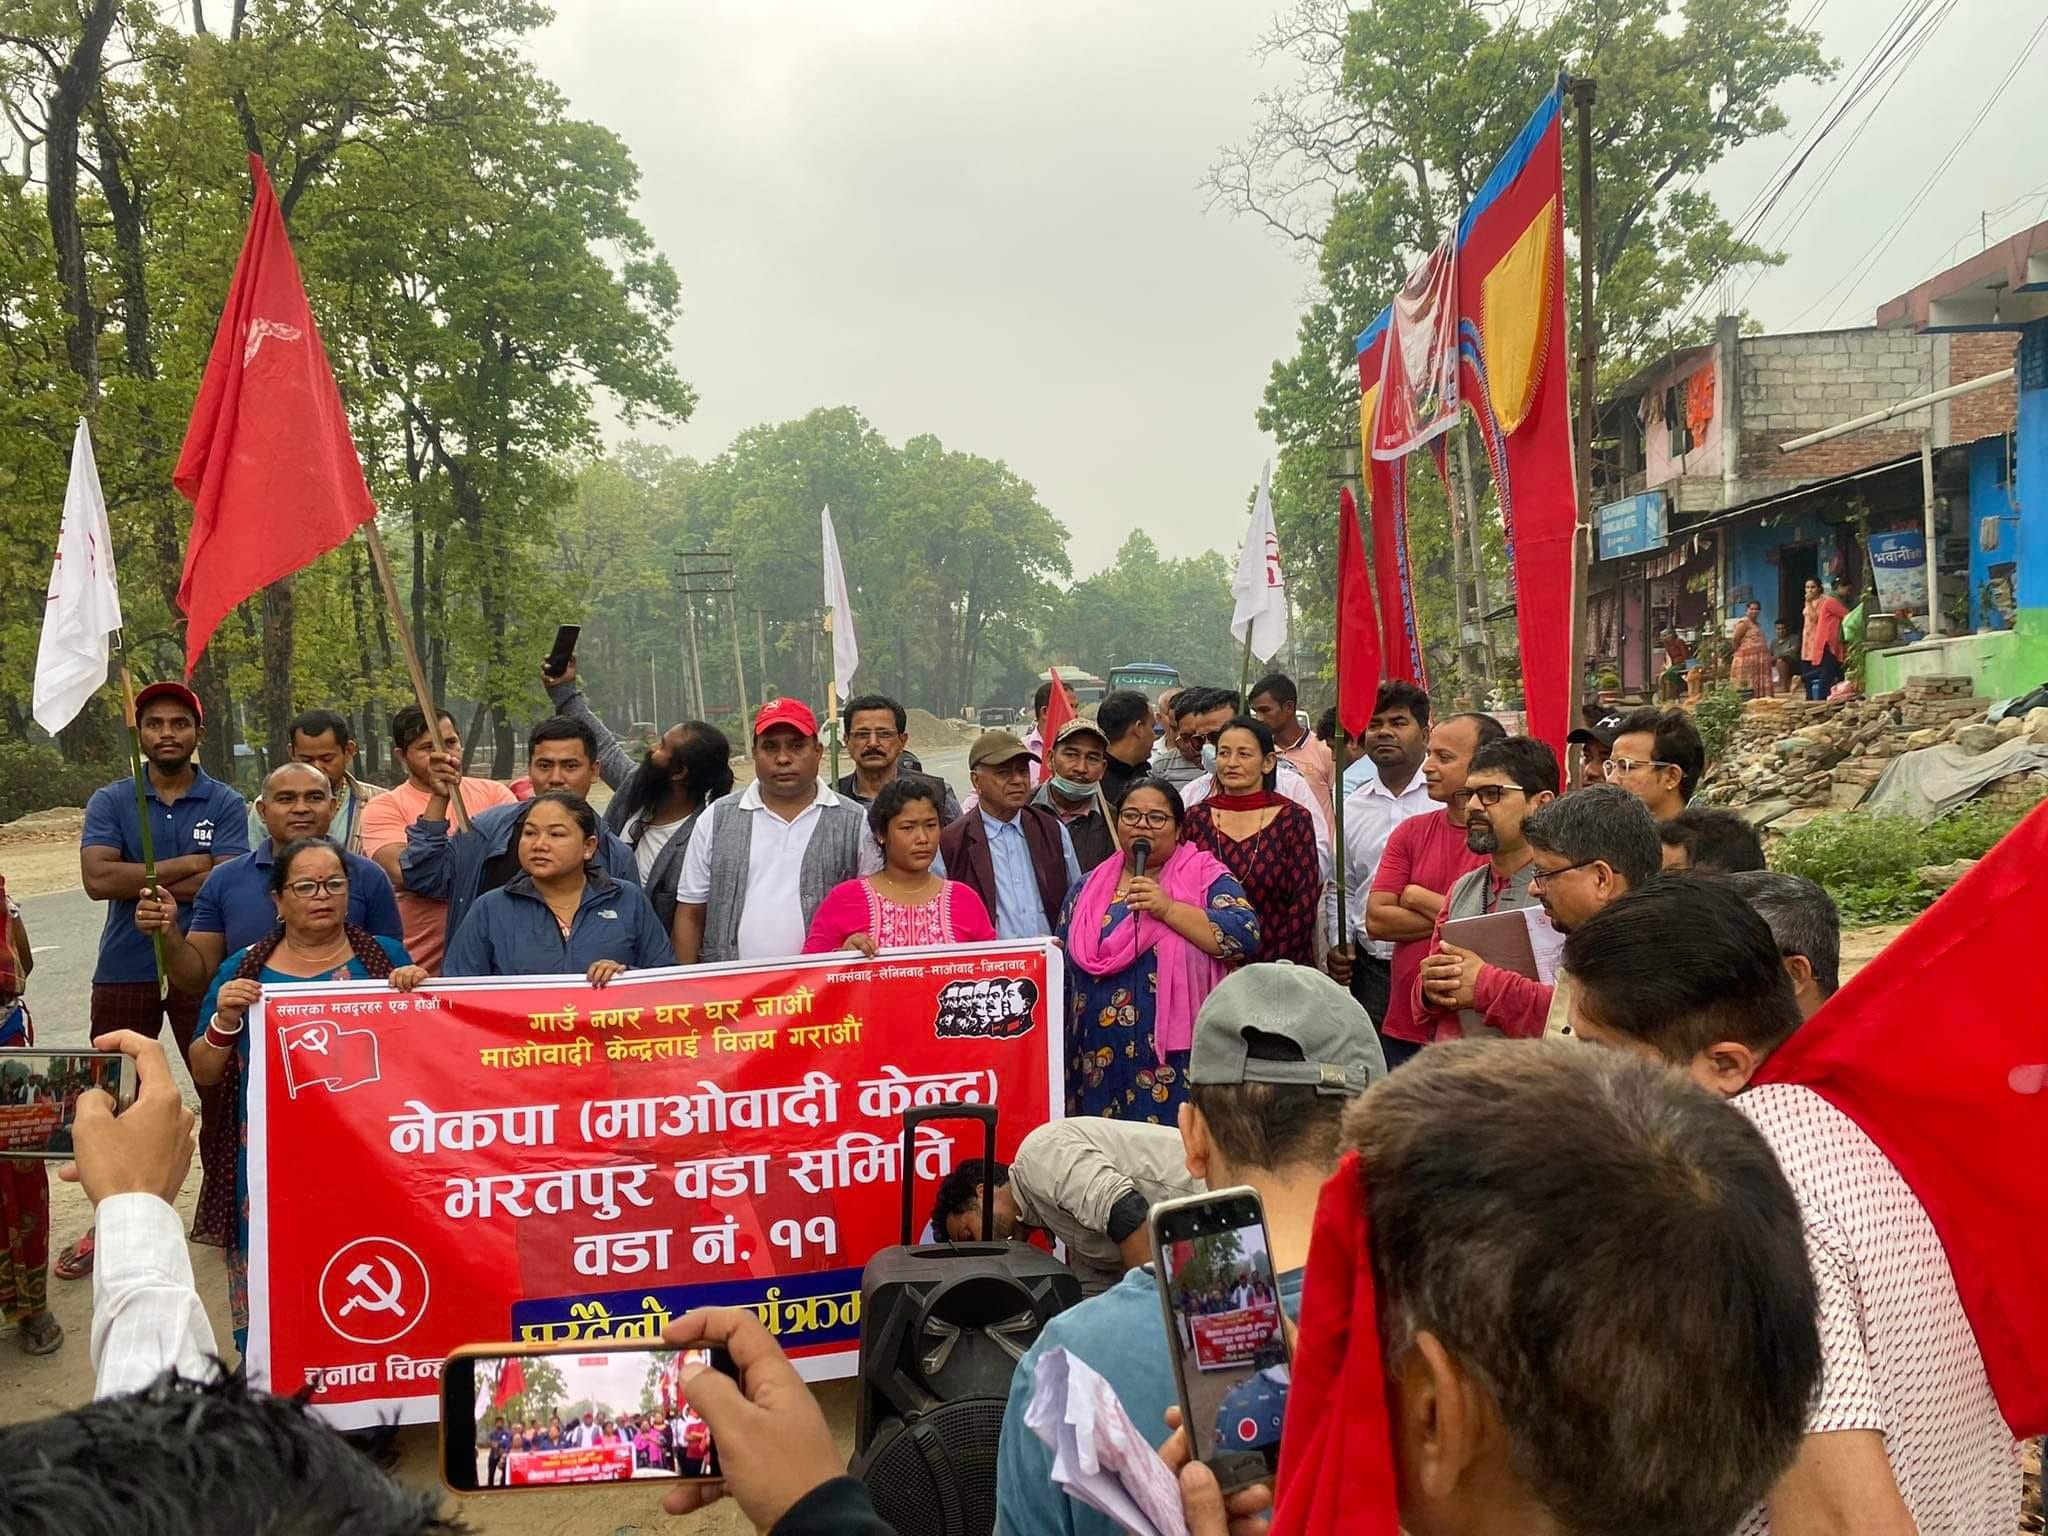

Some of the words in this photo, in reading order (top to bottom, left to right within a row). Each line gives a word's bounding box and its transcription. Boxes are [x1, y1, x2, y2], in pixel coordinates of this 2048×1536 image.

[388, 999, 410, 1014] एक
[528, 1003, 579, 1032] गाउँ
[589, 1007, 645, 1030] नगर
[654, 1002, 696, 1026] घर
[703, 999, 743, 1023] घर
[480, 1037, 594, 1069] माओवादी
[604, 1028, 702, 1062] केन्द्रलाई
[711, 1025, 776, 1055] विजय
[388, 1099, 560, 1154] नेकपा
[579, 1071, 841, 1142] (माओवादी
[444, 1165, 657, 1220] भरतपुर
[674, 1154, 771, 1199] वडा
[573, 1229, 673, 1276] वडा
[690, 1214, 751, 1265] नं.
[769, 1216, 837, 1259] ११
[304, 1362, 377, 1393] चुनाव
